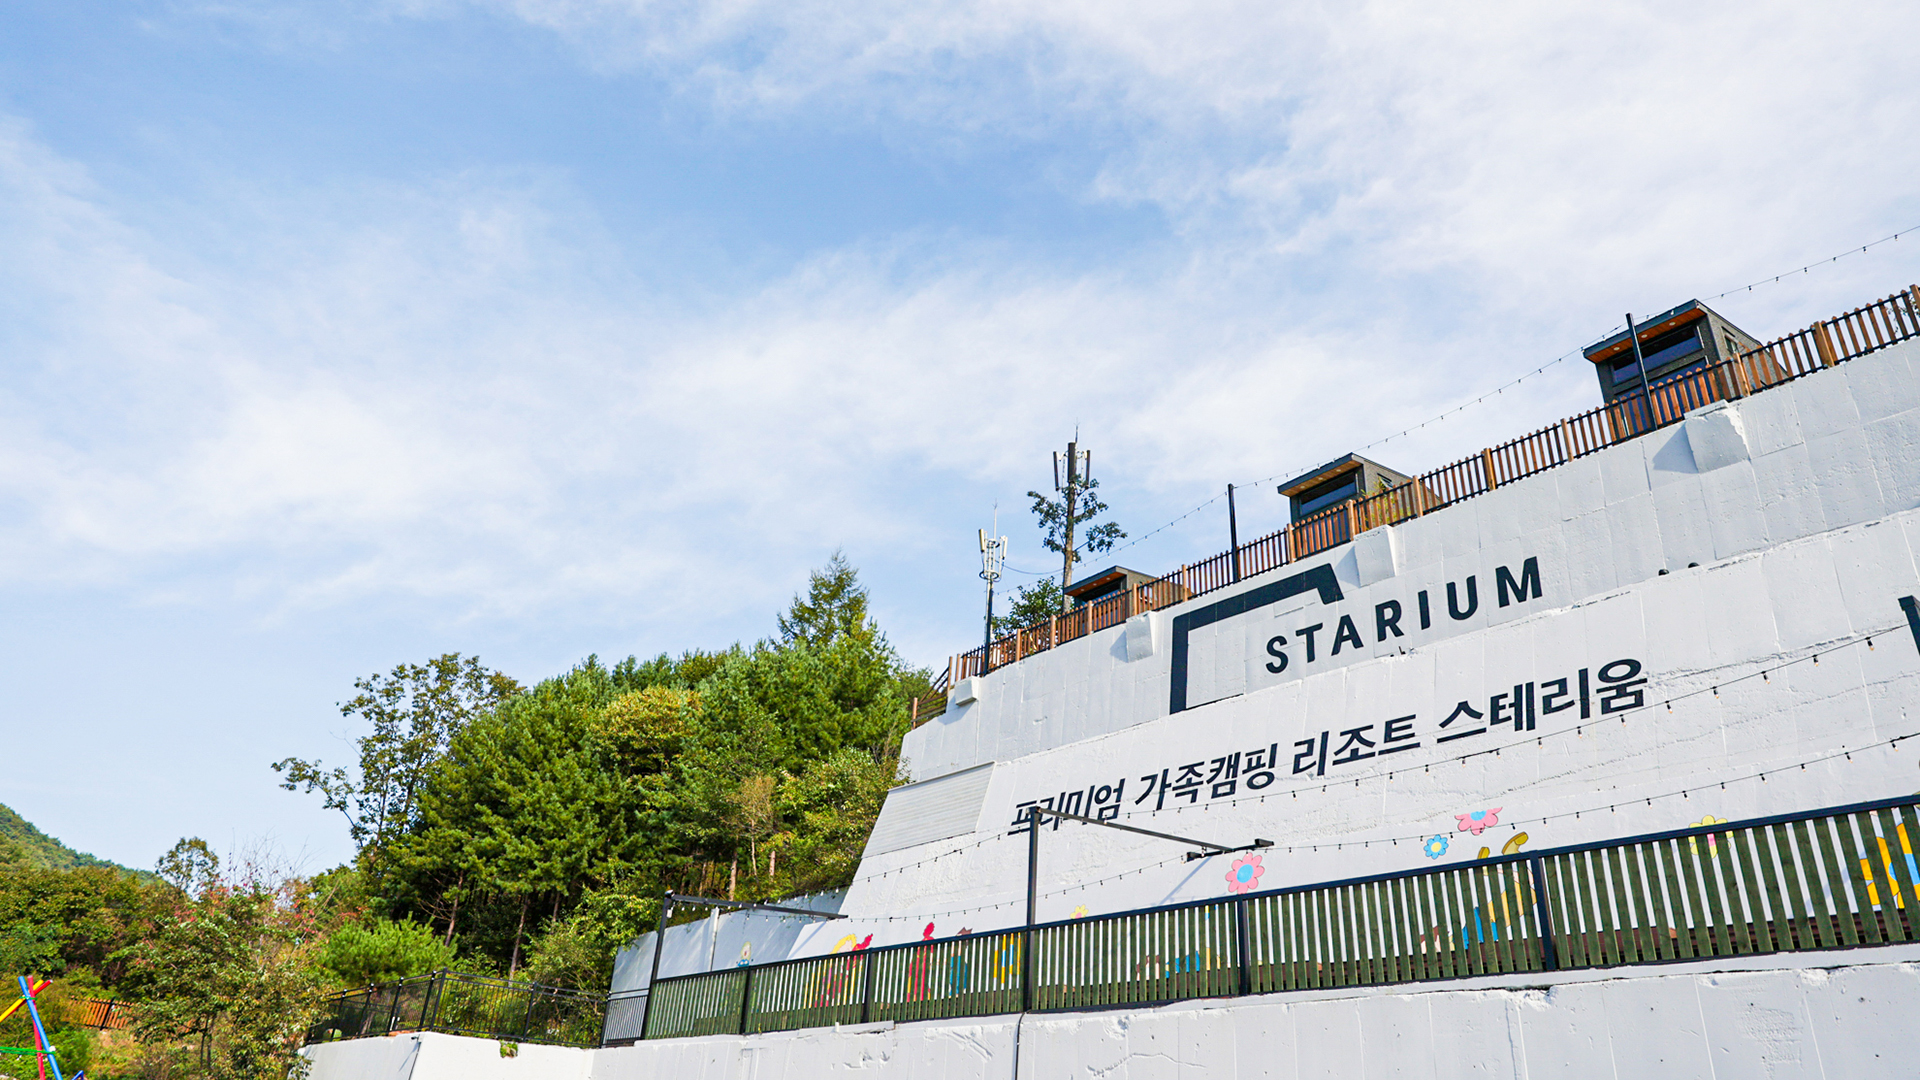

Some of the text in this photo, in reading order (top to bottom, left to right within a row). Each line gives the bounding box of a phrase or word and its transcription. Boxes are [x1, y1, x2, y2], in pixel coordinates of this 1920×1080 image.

[1265, 556, 1543, 674] STARIUM
[1007, 658, 1648, 832] 프리미엄 가족캠핑 리조트 스테리움
